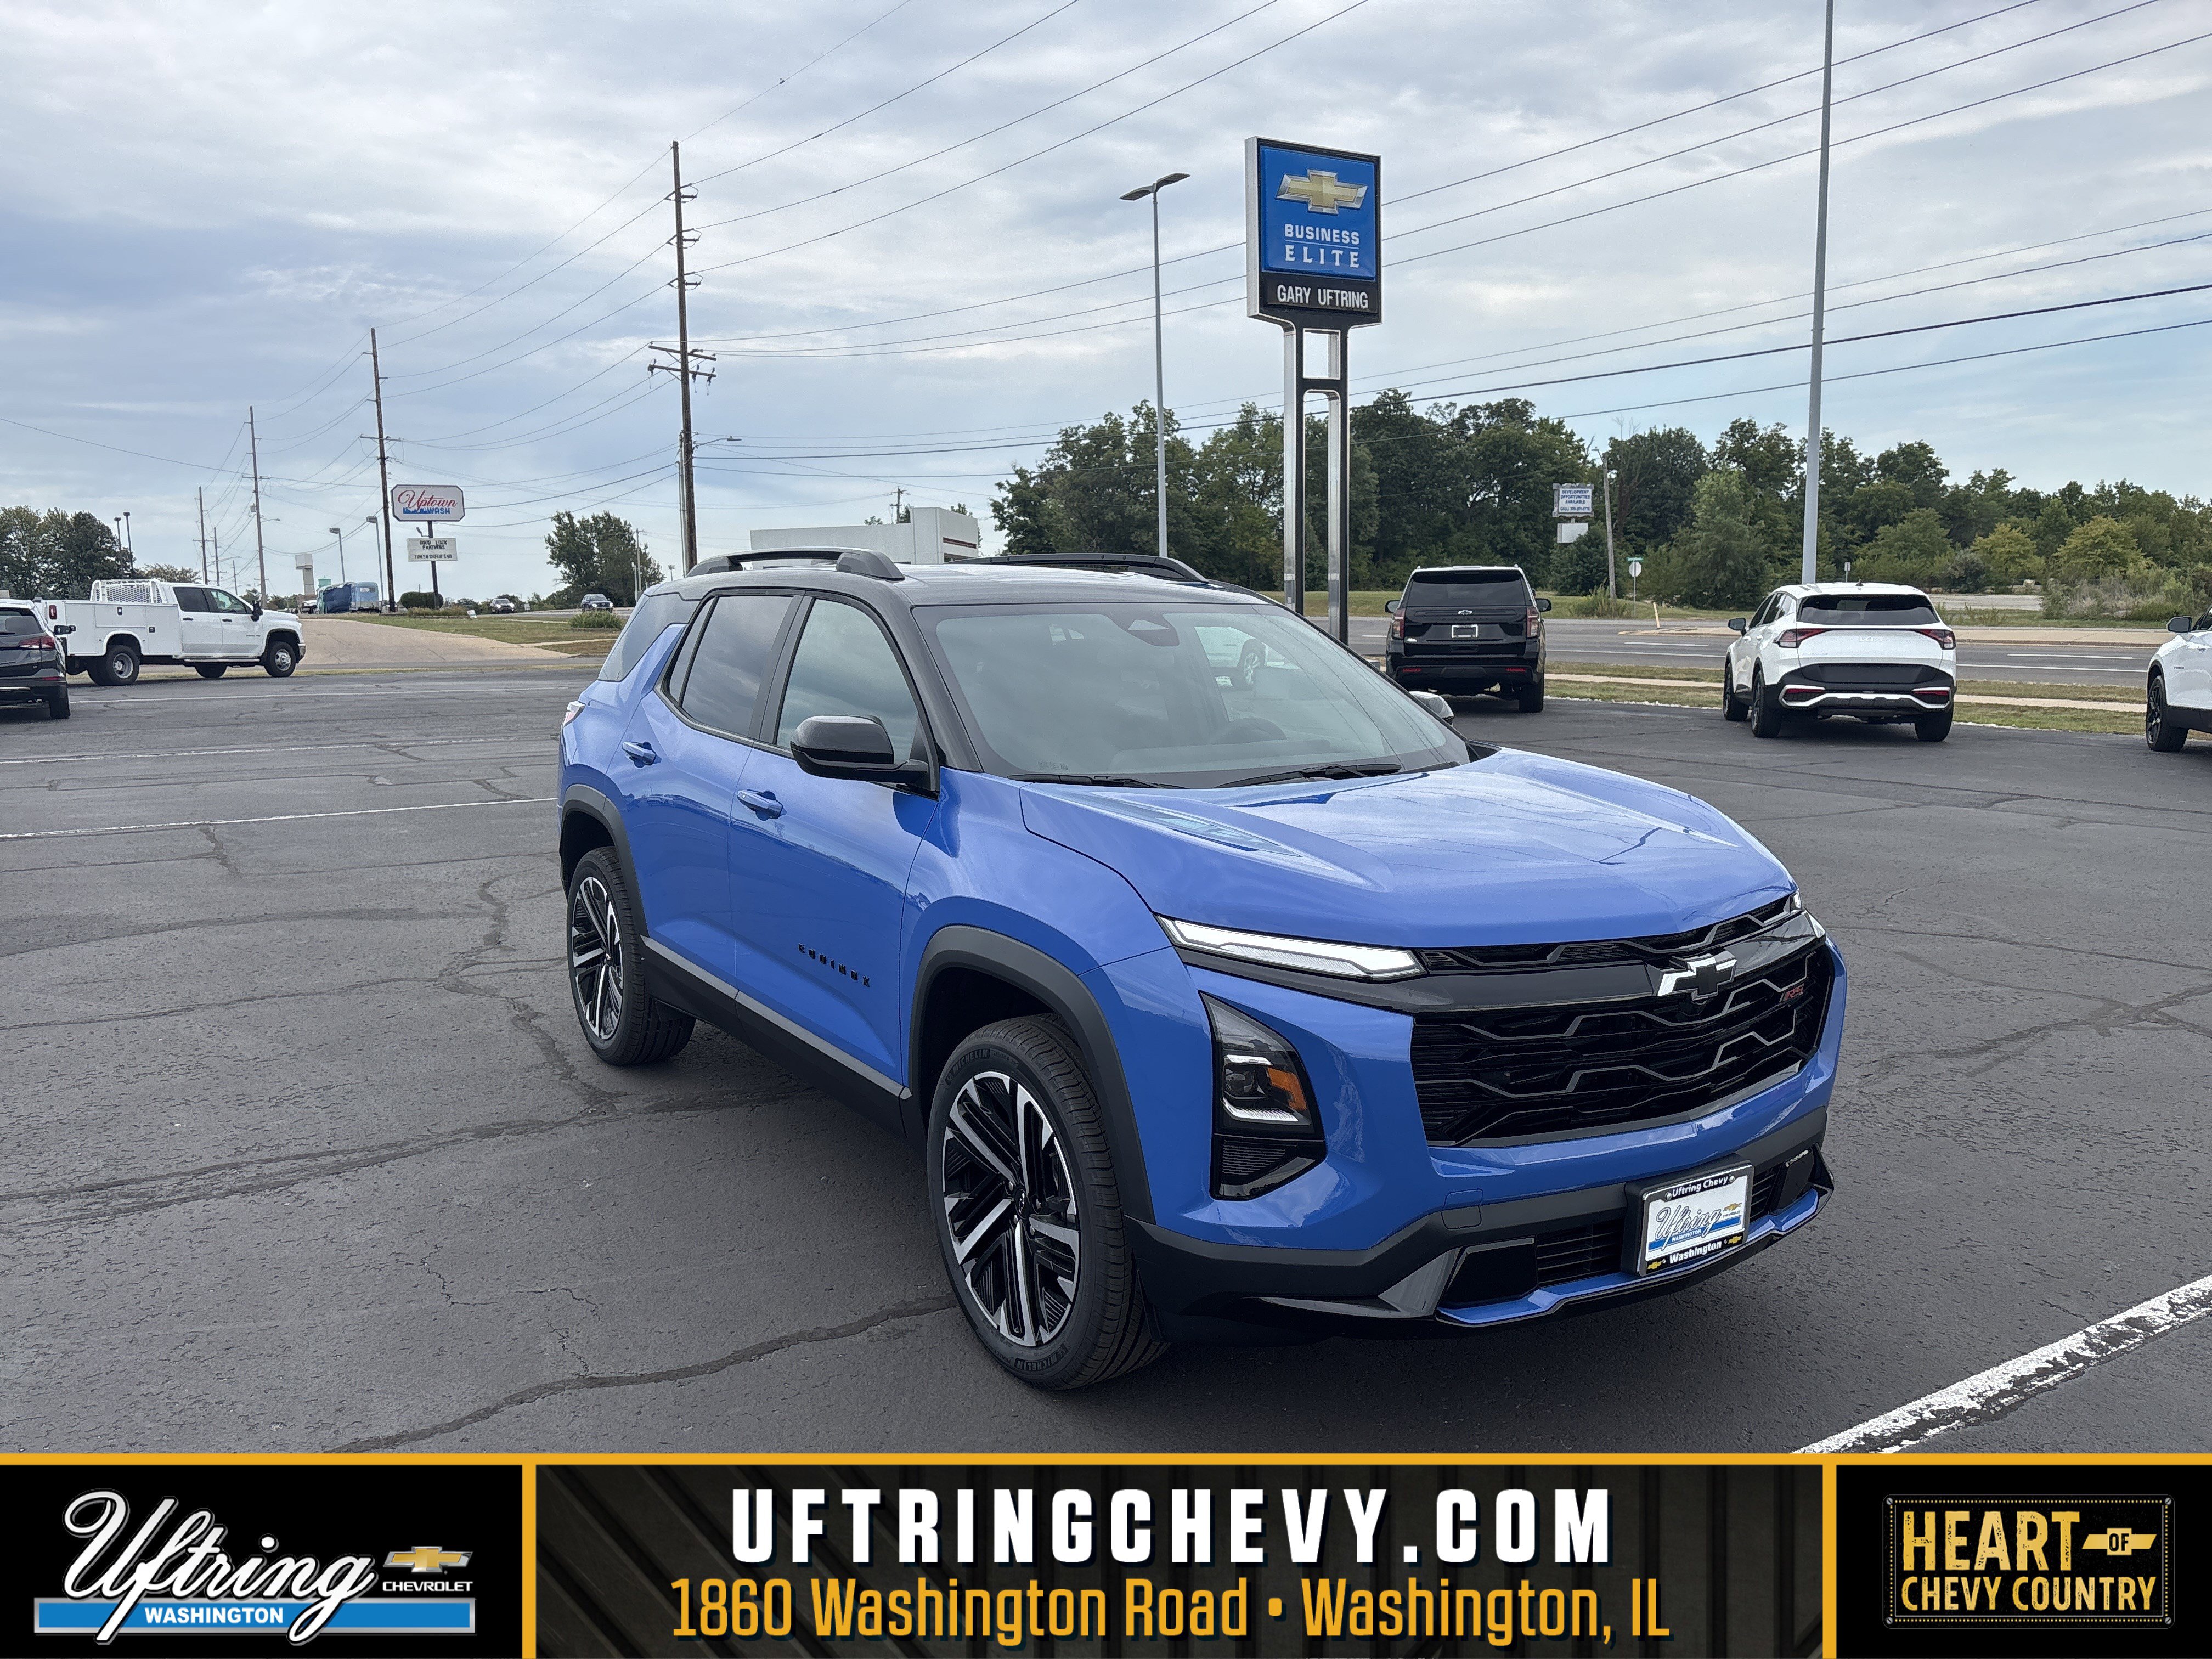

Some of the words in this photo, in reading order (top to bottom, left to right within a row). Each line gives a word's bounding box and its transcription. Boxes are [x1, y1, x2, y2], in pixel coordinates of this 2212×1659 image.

[1284, 223, 1360, 246] BUSINESS
[1285, 244, 1360, 269] ELITE
[1277, 284, 1311, 304] GARY
[1318, 288, 1368, 309] UFTRING
[397, 489, 458, 511] Uptown
[798, 943, 871, 988] EQUINOX
[952, 1048, 990, 1074] MICHELIN
[1672, 1182, 1701, 1198] Uftring
[1703, 1176, 1729, 1189] Chevy
[1654, 1204, 1722, 1251] Uftring
[1671, 1228, 1701, 1242] WASHINGTON
[1669, 1240, 1722, 1264] Washington
[1017, 1353, 1058, 1370] MICHELIN
